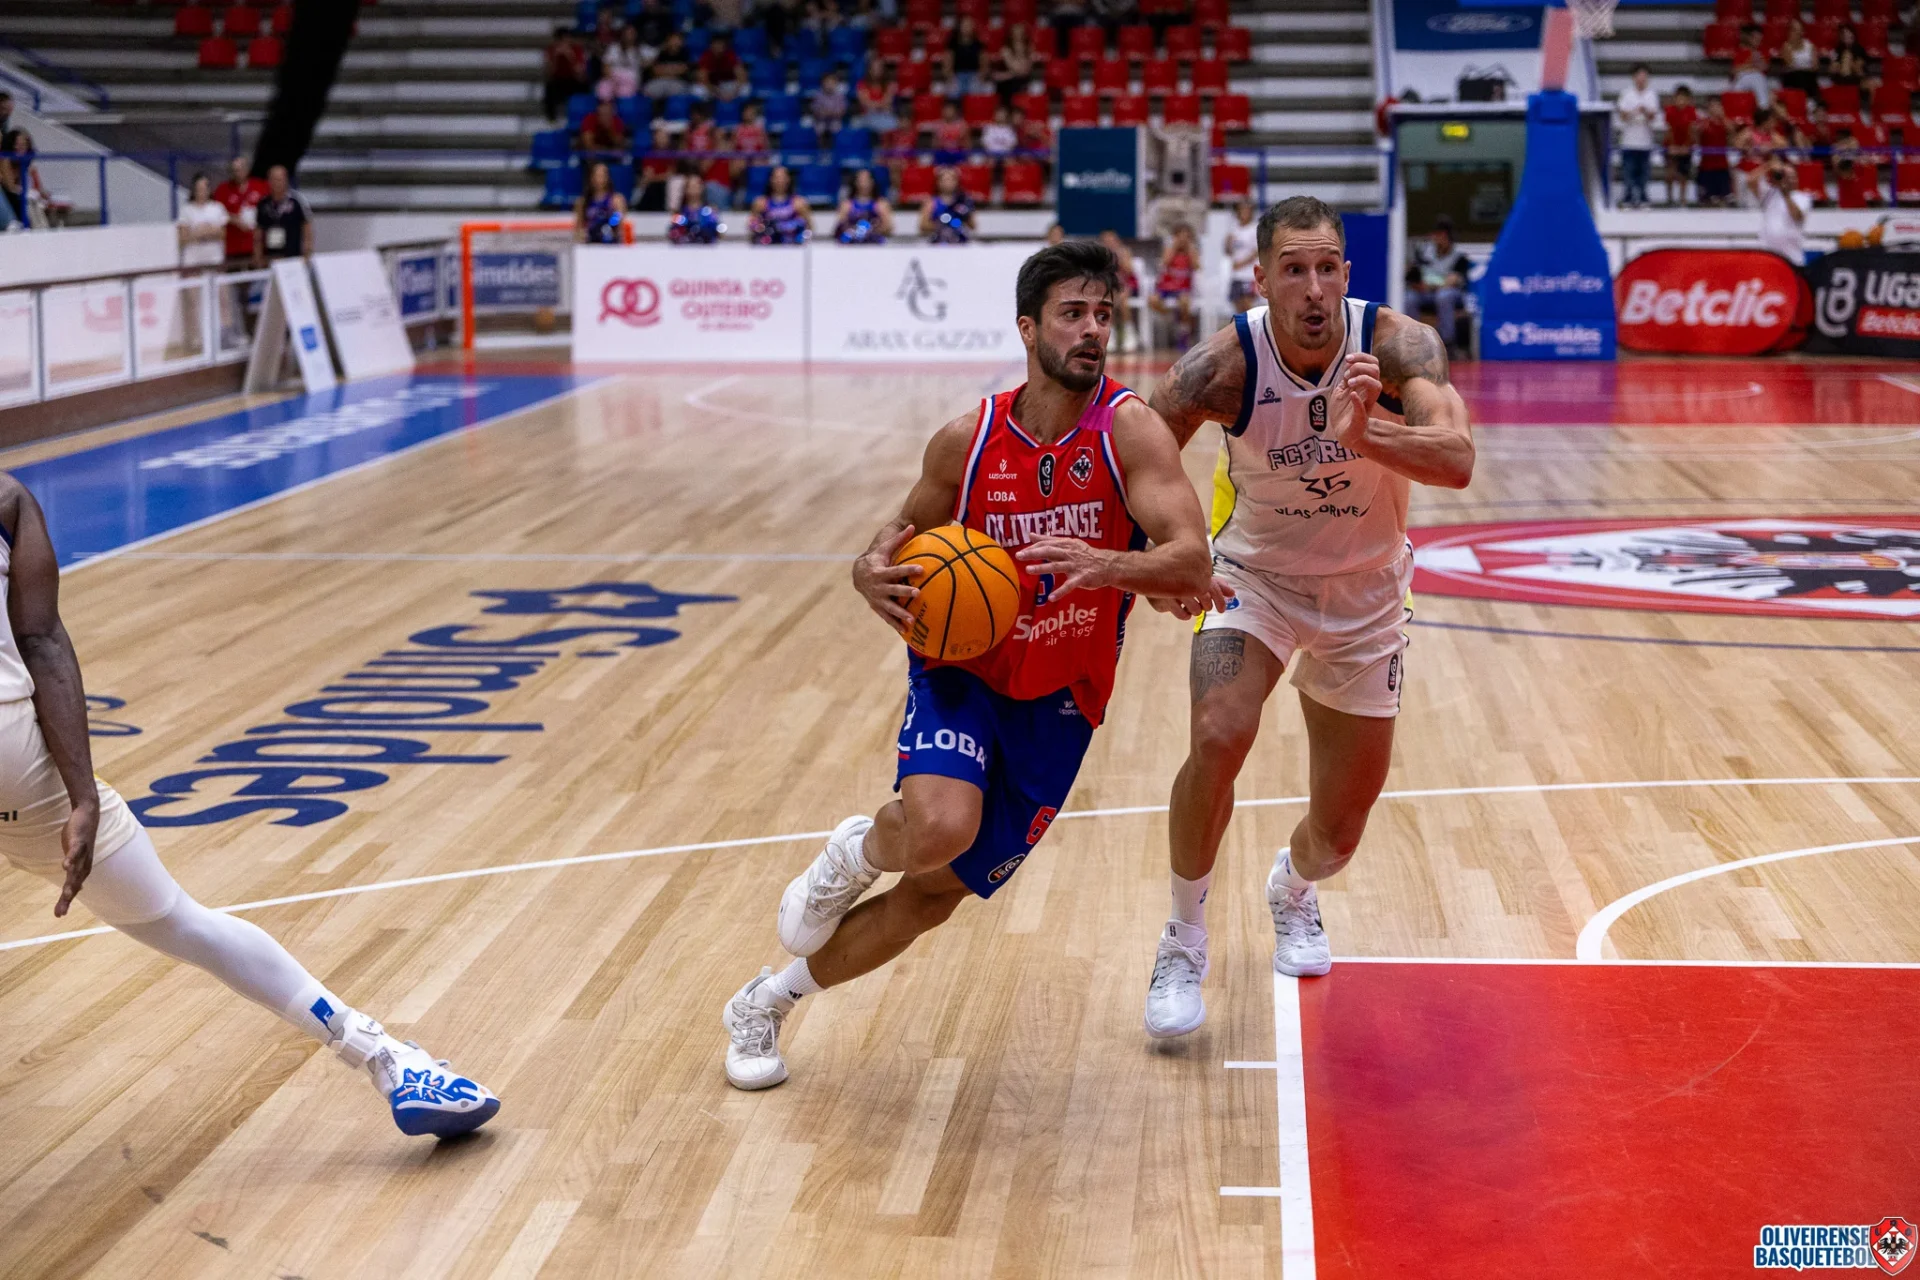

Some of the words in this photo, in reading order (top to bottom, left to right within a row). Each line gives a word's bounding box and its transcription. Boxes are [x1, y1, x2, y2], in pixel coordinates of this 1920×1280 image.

[749, 278, 786, 299] DO
[1621, 277, 1787, 328] Betclic
[987, 491, 1017, 502] LOBA
[1299, 471, 1351, 500] 35
[1012, 603, 1099, 643] Smoldes
[1025, 805, 1064, 845] 6
